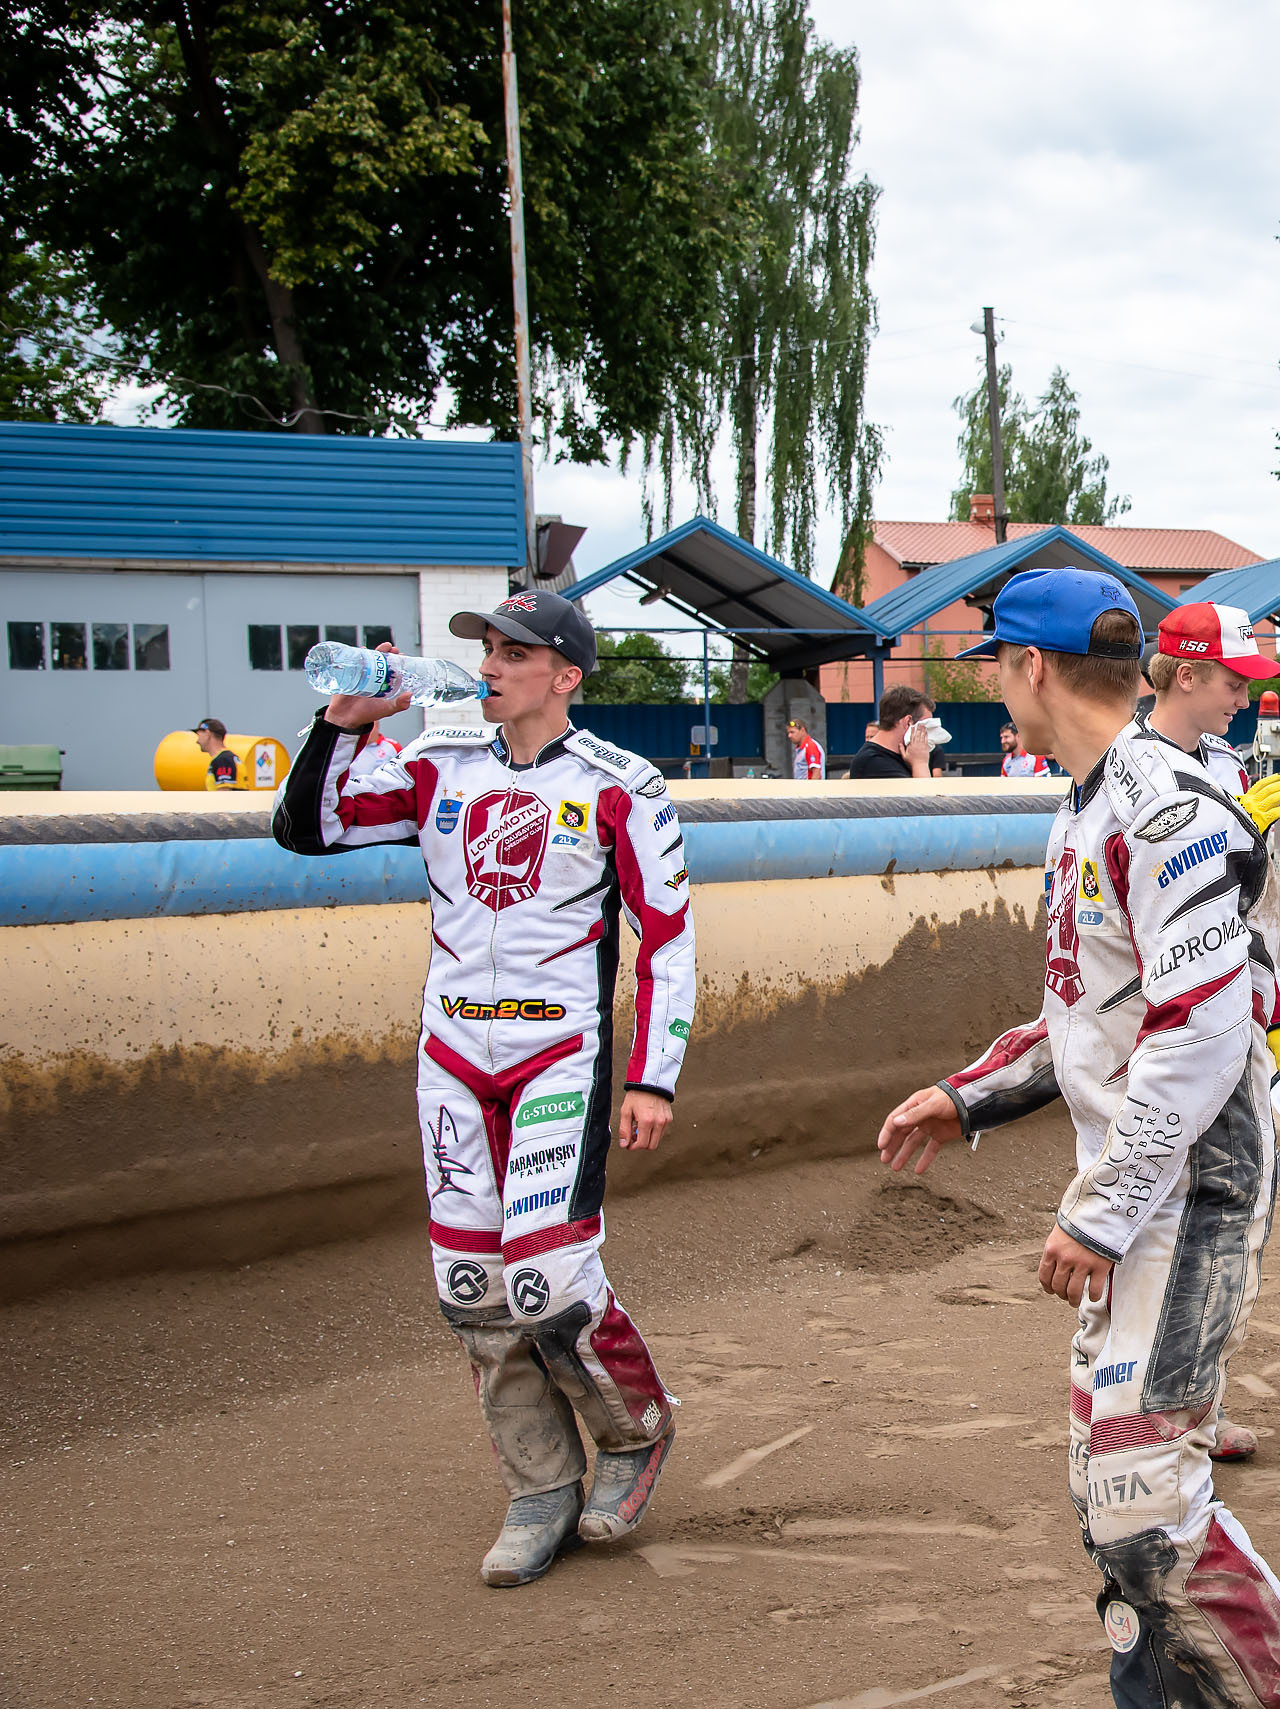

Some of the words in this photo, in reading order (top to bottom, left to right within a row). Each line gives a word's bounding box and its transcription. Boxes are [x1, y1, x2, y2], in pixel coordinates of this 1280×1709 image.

[1178, 639, 1210, 653] #56
[470, 803, 539, 857] LOKOMOTIV
[440, 995, 567, 1021] Van2Go
[522, 1099, 577, 1121] G-STOCK
[509, 1144, 577, 1175] BARANOWSKY
[1086, 1095, 1150, 1201] YOGGI
[1110, 1105, 1161, 1212] GASTROBARS
[520, 1160, 567, 1179] FAMILY
